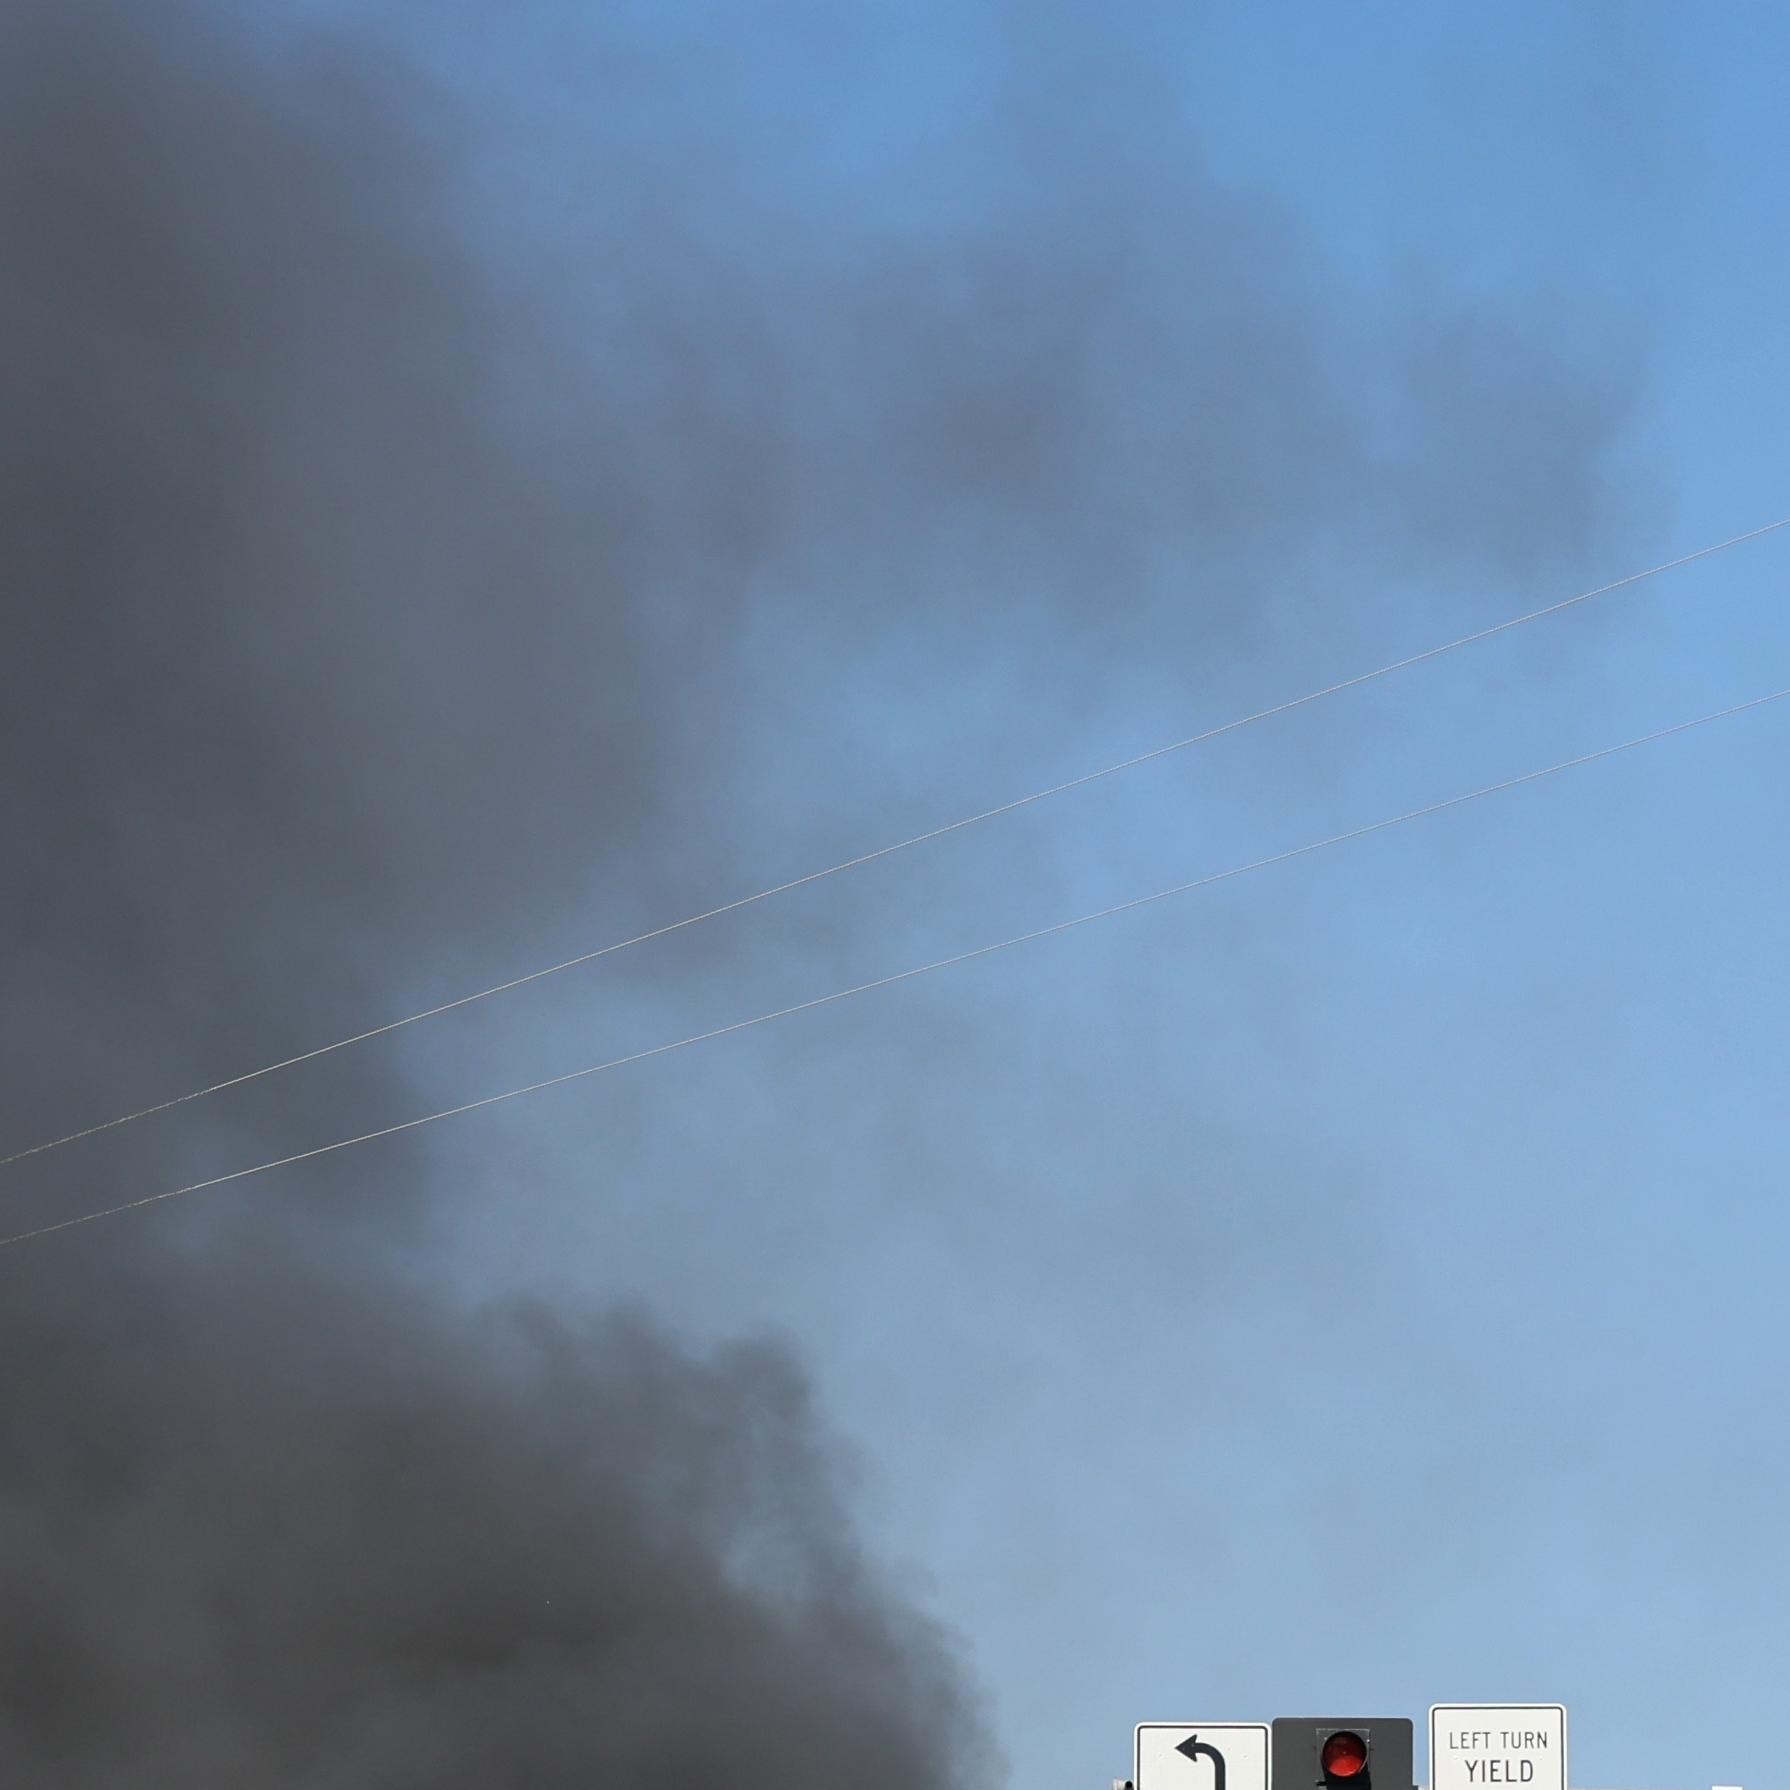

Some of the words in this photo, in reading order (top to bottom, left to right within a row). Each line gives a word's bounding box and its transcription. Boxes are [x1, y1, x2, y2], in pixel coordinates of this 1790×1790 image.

[1449, 1731, 1492, 1750] LEFT
[1500, 1731, 1548, 1750] TURN
[1464, 1760, 1534, 1783] YIELD
